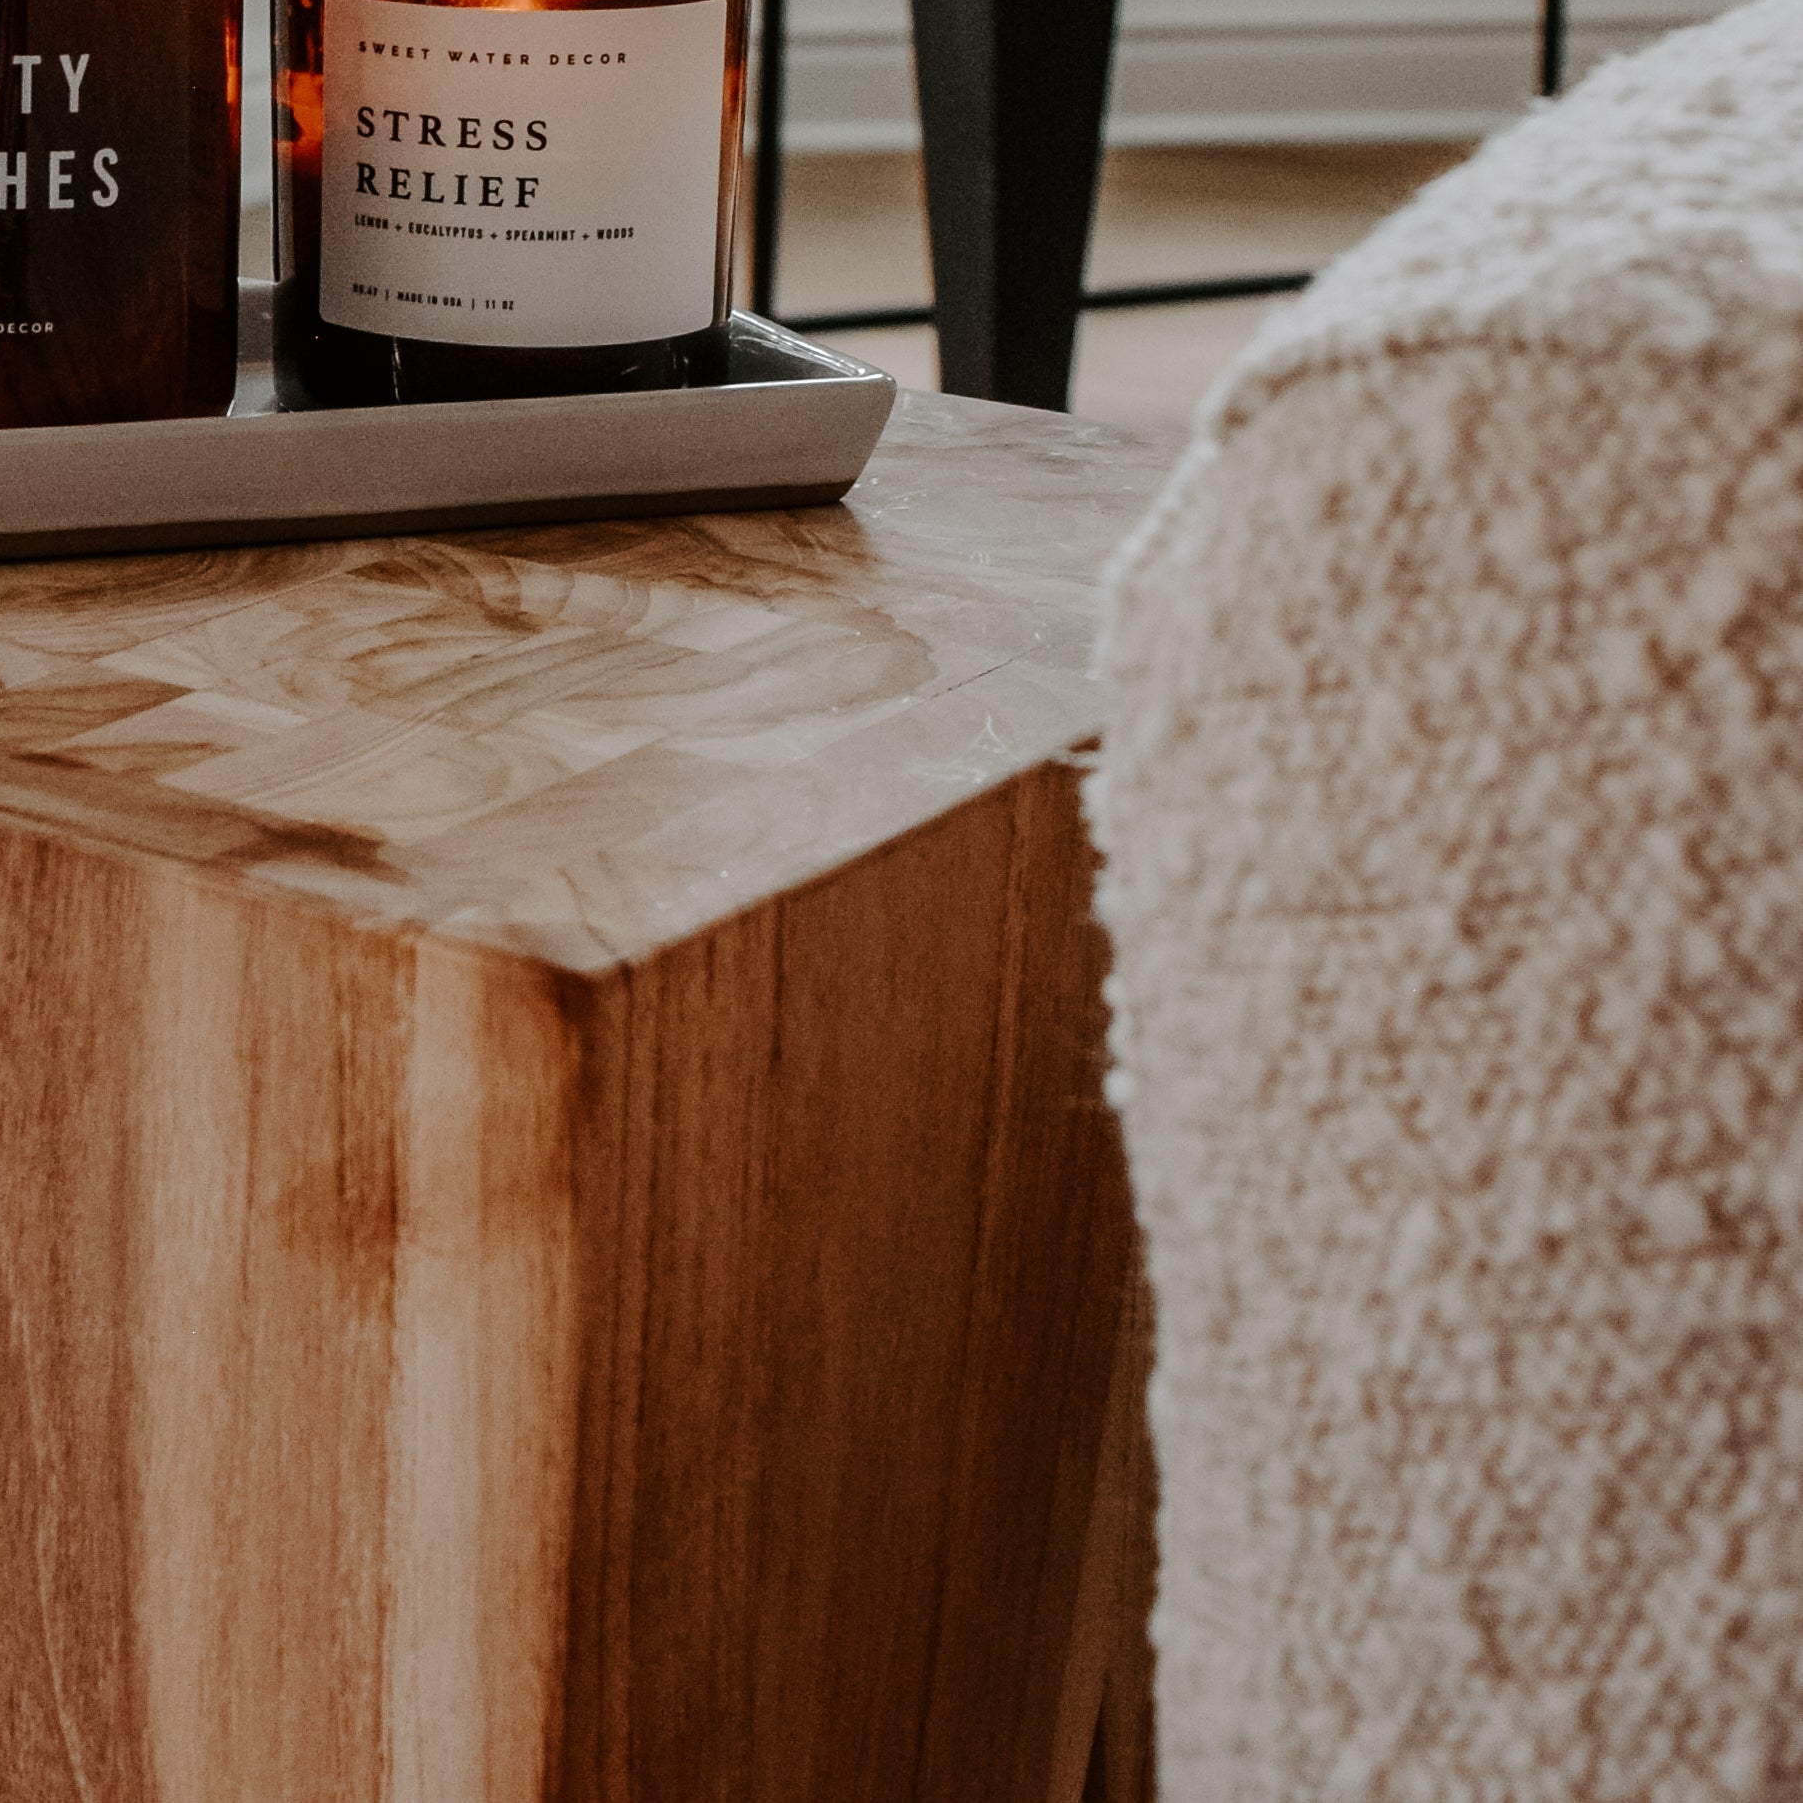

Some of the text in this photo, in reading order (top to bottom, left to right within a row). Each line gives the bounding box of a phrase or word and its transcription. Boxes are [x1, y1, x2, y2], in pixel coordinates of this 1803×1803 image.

[358, 40, 627, 65] SWEET WATER DECOR
[355, 106, 549, 152] STRESS
[354, 162, 541, 209] RELIEF
[354, 213, 389, 230] LEMON
[408, 222, 484, 240] EUCALYPTUS
[505, 229, 576, 242] SPEARMINT
[596, 227, 635, 240] WOODS
[397, 291, 423, 304] MADE
[427, 294, 439, 305] IN
[443, 296, 463, 308] USA
[485, 299, 497, 310] 11
[502, 299, 515, 311] OZ
